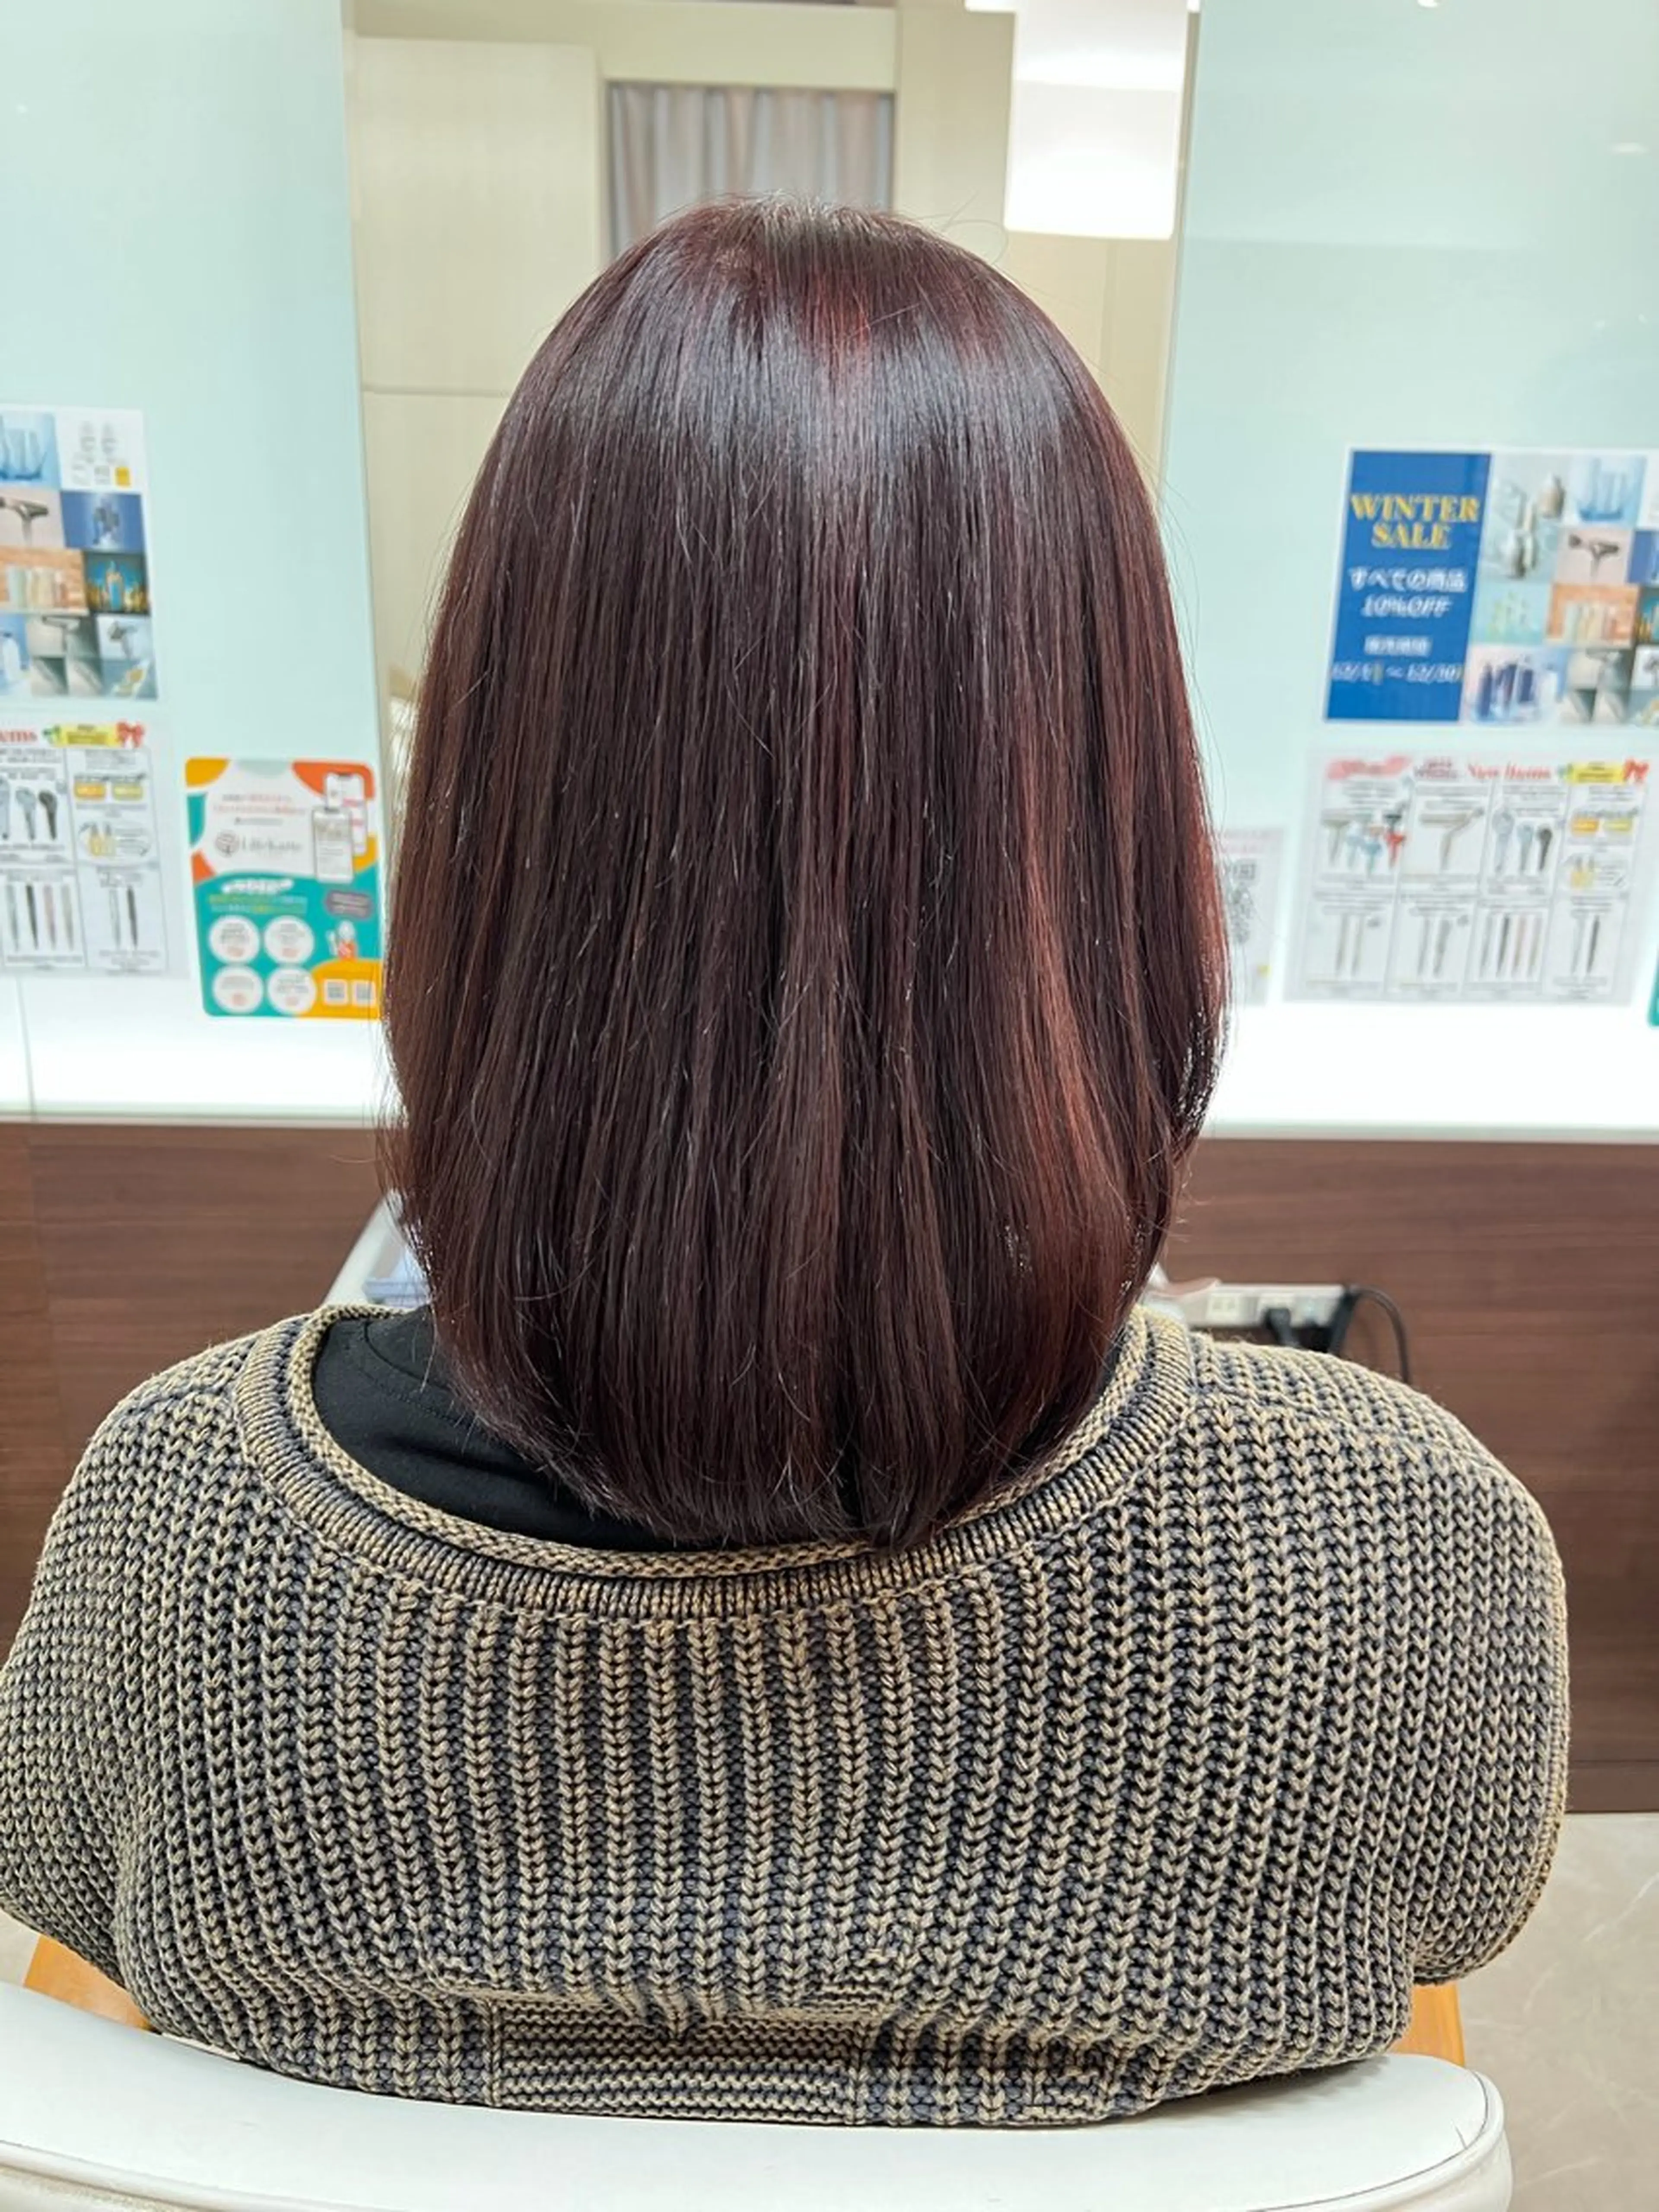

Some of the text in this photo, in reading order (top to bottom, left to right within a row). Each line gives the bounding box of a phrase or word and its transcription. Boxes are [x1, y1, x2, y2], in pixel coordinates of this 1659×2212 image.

[1351, 494, 1479, 522] WINTER
[1372, 521, 1451, 550] SALE
[1348, 567, 1468, 592] すべての商品
